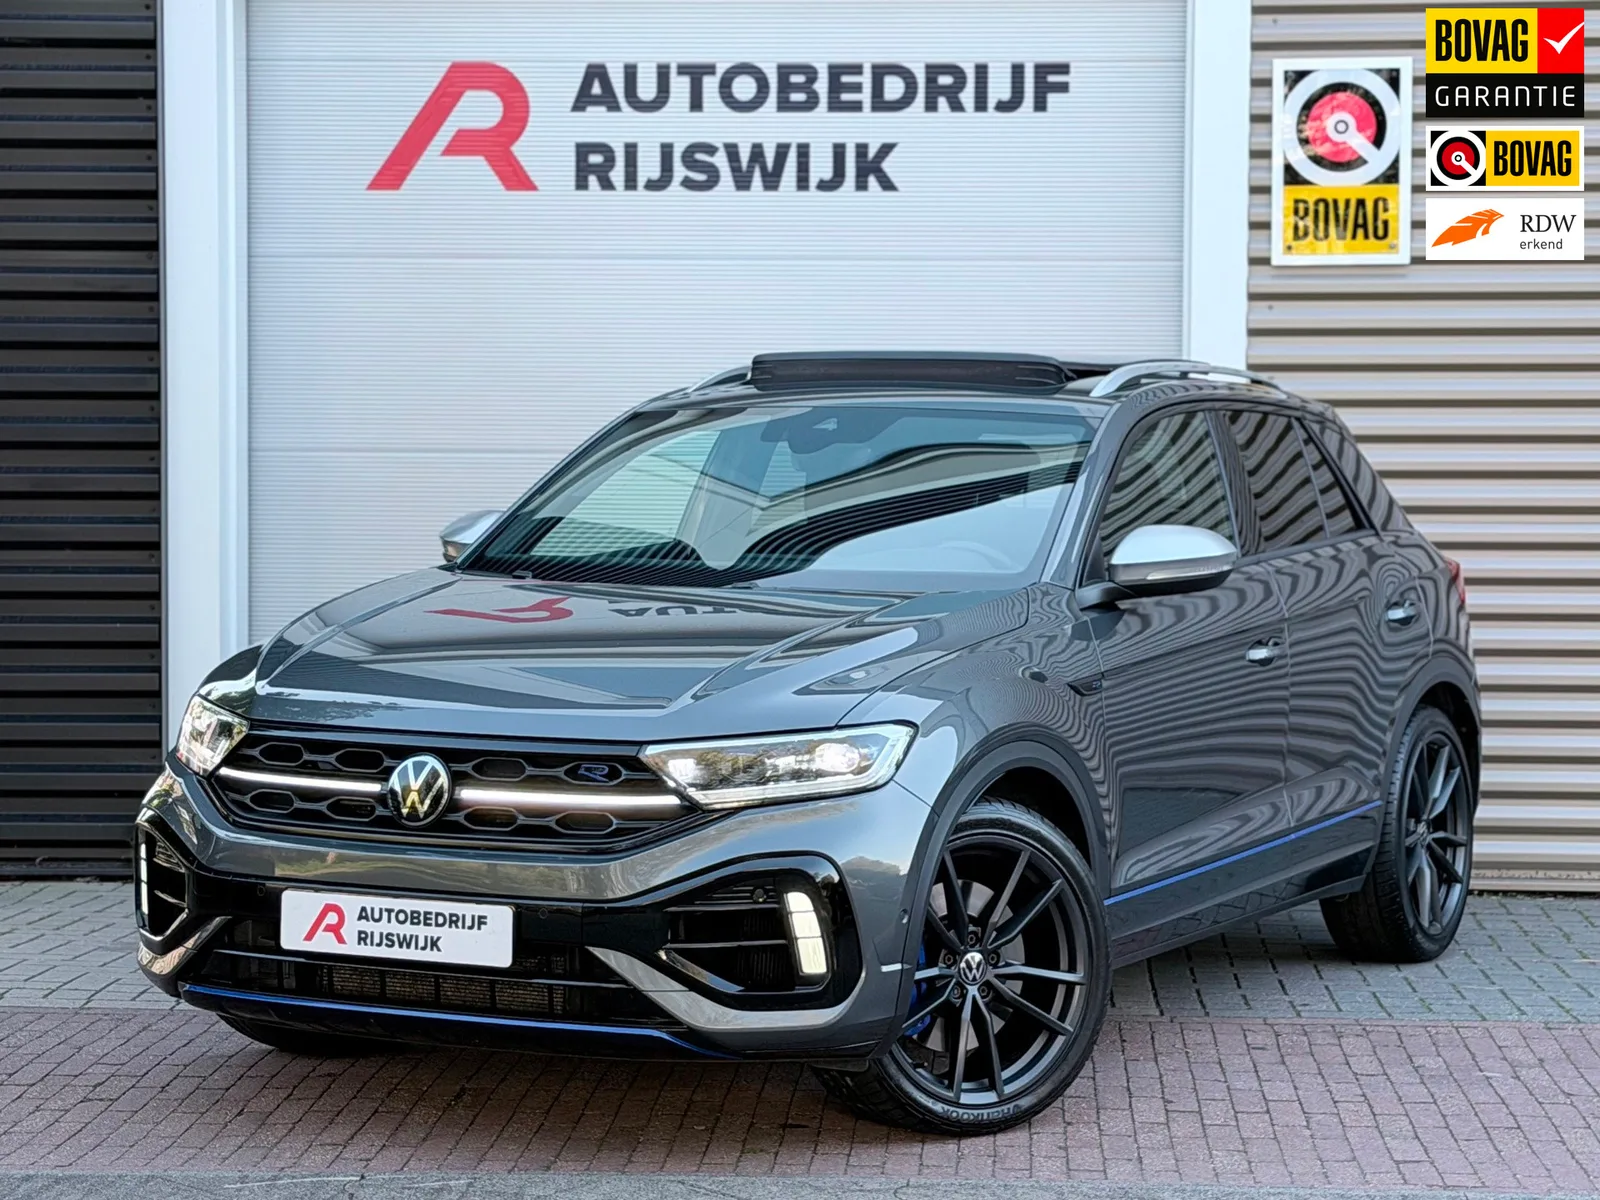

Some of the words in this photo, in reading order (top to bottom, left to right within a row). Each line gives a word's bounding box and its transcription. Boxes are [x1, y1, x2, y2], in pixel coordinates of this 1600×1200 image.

[570, 62, 1071, 112] AUTOBEDRIJF
[574, 142, 900, 192] RIJSWIJK
[1292, 197, 1390, 242] BOVAG
[356, 906, 488, 931] AUTOBEDRIJF
[357, 930, 442, 953] RIJSWIJK
